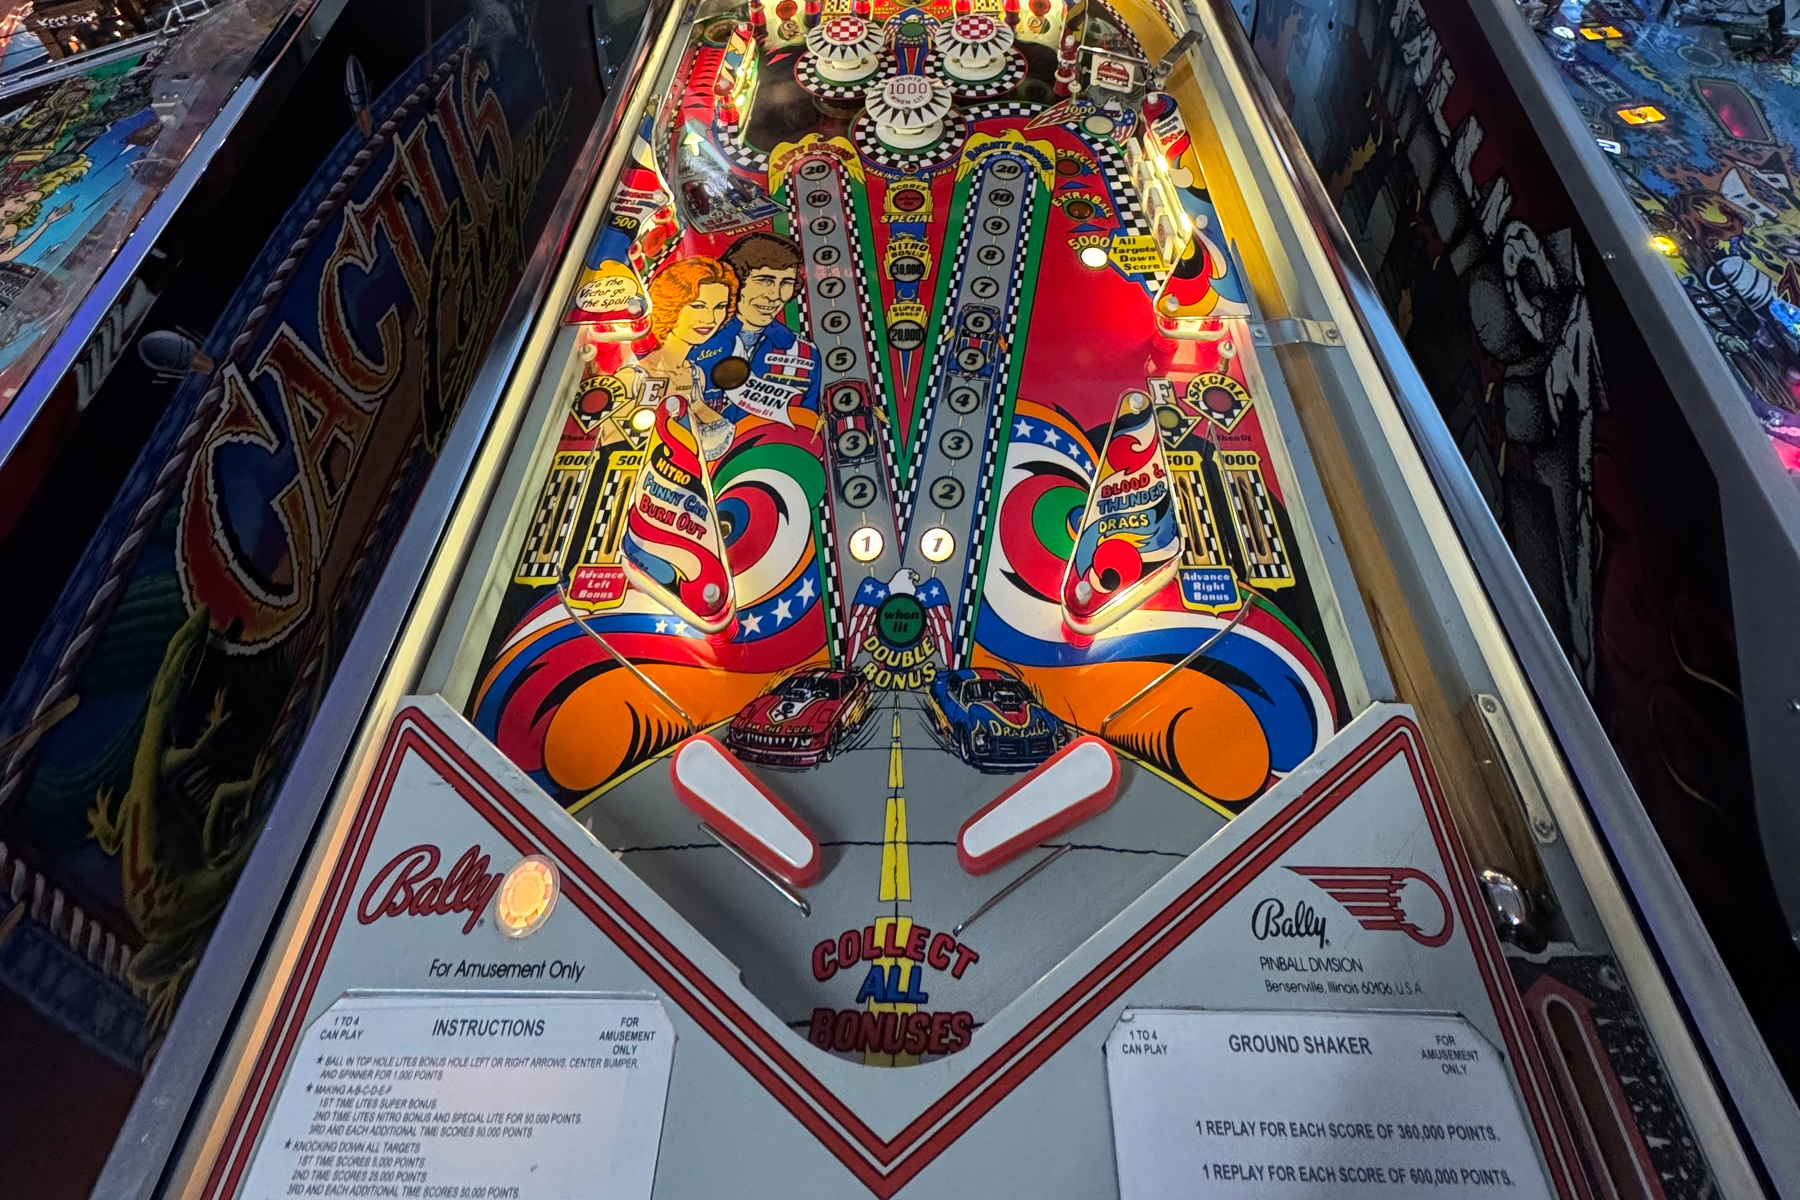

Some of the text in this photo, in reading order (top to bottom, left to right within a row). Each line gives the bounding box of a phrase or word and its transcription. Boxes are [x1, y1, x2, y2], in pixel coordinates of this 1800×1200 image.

[889, 83, 928, 95] 1000
[1064, 105, 1097, 115] 1000
[772, 143, 855, 171] LEFT BONUS
[965, 141, 1054, 170] RIGHT BONUS
[1056, 148, 1100, 175] SPECIAL
[891, 183, 928, 192] SCORES
[1051, 191, 1113, 218] EXTRA BALL
[612, 215, 637, 229] 500
[880, 213, 935, 223] SPECIAL
[888, 242, 929, 252] NITRO
[1067, 234, 1111, 251] 5000
[1118, 237, 1136, 246] All
[891, 250, 926, 258] BONUS
[1113, 246, 1156, 256] Targets
[1120, 254, 1156, 262] Down
[1124, 263, 1160, 271] Score
[605, 278, 623, 286] the
[580, 288, 625, 298] Victor go
[581, 295, 634, 308] the spoil
[891, 305, 922, 313] SUPER
[696, 347, 724, 361] Steve
[640, 380, 665, 406] E
[745, 379, 794, 399] SHOOT
[1150, 380, 1172, 405] F
[1189, 376, 1243, 399] SPECIAL
[740, 390, 785, 409] AGAIN
[738, 400, 773, 417] When lit
[557, 455, 596, 466] 1000
[655, 458, 691, 485] NITRO
[1101, 463, 1166, 498] BLOOD &
[643, 471, 708, 521] FUNNY CAR
[1097, 482, 1167, 515] THUNDER
[639, 497, 707, 540] BURN OUT
[1098, 514, 1149, 534] DRAGS
[577, 570, 624, 580] Advance
[1183, 572, 1230, 581] Advance
[587, 580, 610, 589] Left
[1193, 581, 1225, 591] Right
[578, 590, 613, 599] Bonus
[1193, 592, 1229, 601] Bonus
[884, 611, 920, 621] when
[892, 621, 908, 633] lit
[862, 634, 936, 667] DOUBLE
[861, 661, 936, 690] BONUS
[357, 843, 505, 935] Bally
[1251, 898, 1327, 949] Bally
[812, 923, 979, 982] COLLECT
[1260, 956, 1363, 972] PINBALL DIVISION
[429, 959, 585, 983] For Amusement Only
[855, 965, 928, 1004] ALL
[432, 1019, 545, 1037] INSTRUCTIONS
[621, 1017, 640, 1027] FOR
[319, 1029, 364, 1040] CAN PLAY
[599, 1031, 656, 1042] AMUSEMENT
[807, 1008, 974, 1055] BONUSES
[1229, 1034, 1373, 1055] GROUND SHAKER
[1436, 1035, 1456, 1046] FOR
[612, 1045, 638, 1055] ONLY
[1122, 1044, 1167, 1055] CAN PLAY
[1422, 1049, 1479, 1061] AMUSEMENT
[325, 1055, 344, 1066] BALL
[345, 1055, 354, 1066] IN
[355, 1055, 372, 1066] TOP
[373, 1055, 394, 1066] HOLE
[395, 1056, 417, 1066] LITES
[418, 1056, 446, 1066] BONUS
[447, 1056, 469, 1067] HOLE
[470, 1056, 490, 1067] LEFT
[491, 1056, 503, 1067] OR
[504, 1057, 530, 1067] RIGHT
[569, 1057, 602, 1068] CENTER
[1442, 1064, 1467, 1075] ONLY
[1196, 1121, 1501, 1142] 1 REPLAY FOR EACH SCORE OF 360,000 POINTS.
[1203, 1164, 1515, 1187] 1 REPLAY FOR EACH SCORE OF 600,000 POINTS.
